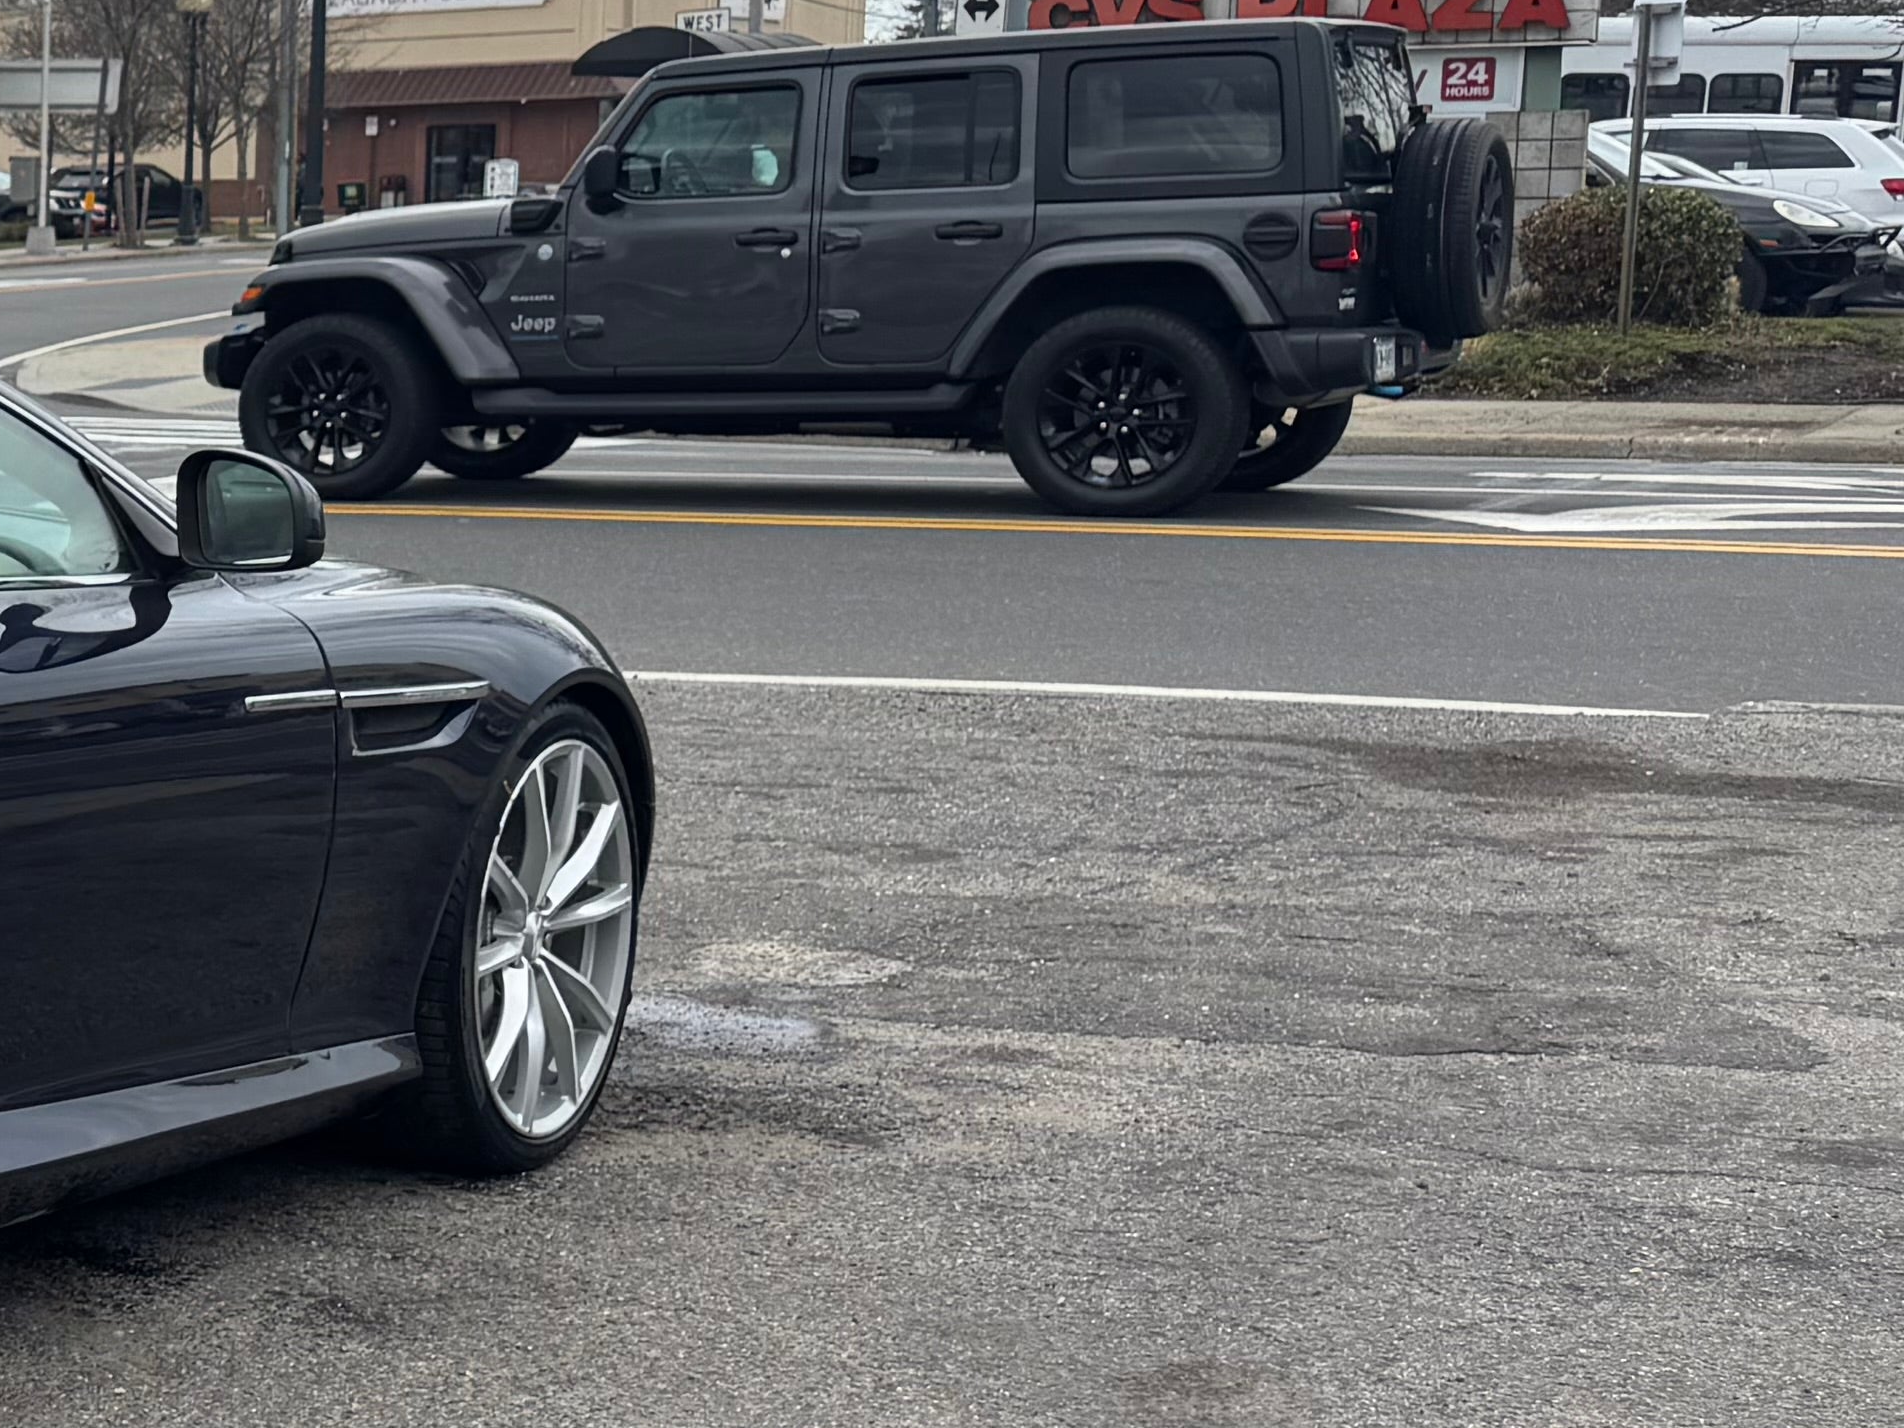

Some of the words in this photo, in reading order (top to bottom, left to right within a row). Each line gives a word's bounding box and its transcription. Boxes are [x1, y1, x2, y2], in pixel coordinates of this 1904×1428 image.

[682, 13, 723, 32] WEST
[1446, 61, 1489, 85] 24
[1444, 86, 1490, 98] HOURS
[510, 314, 557, 333] Jeep
